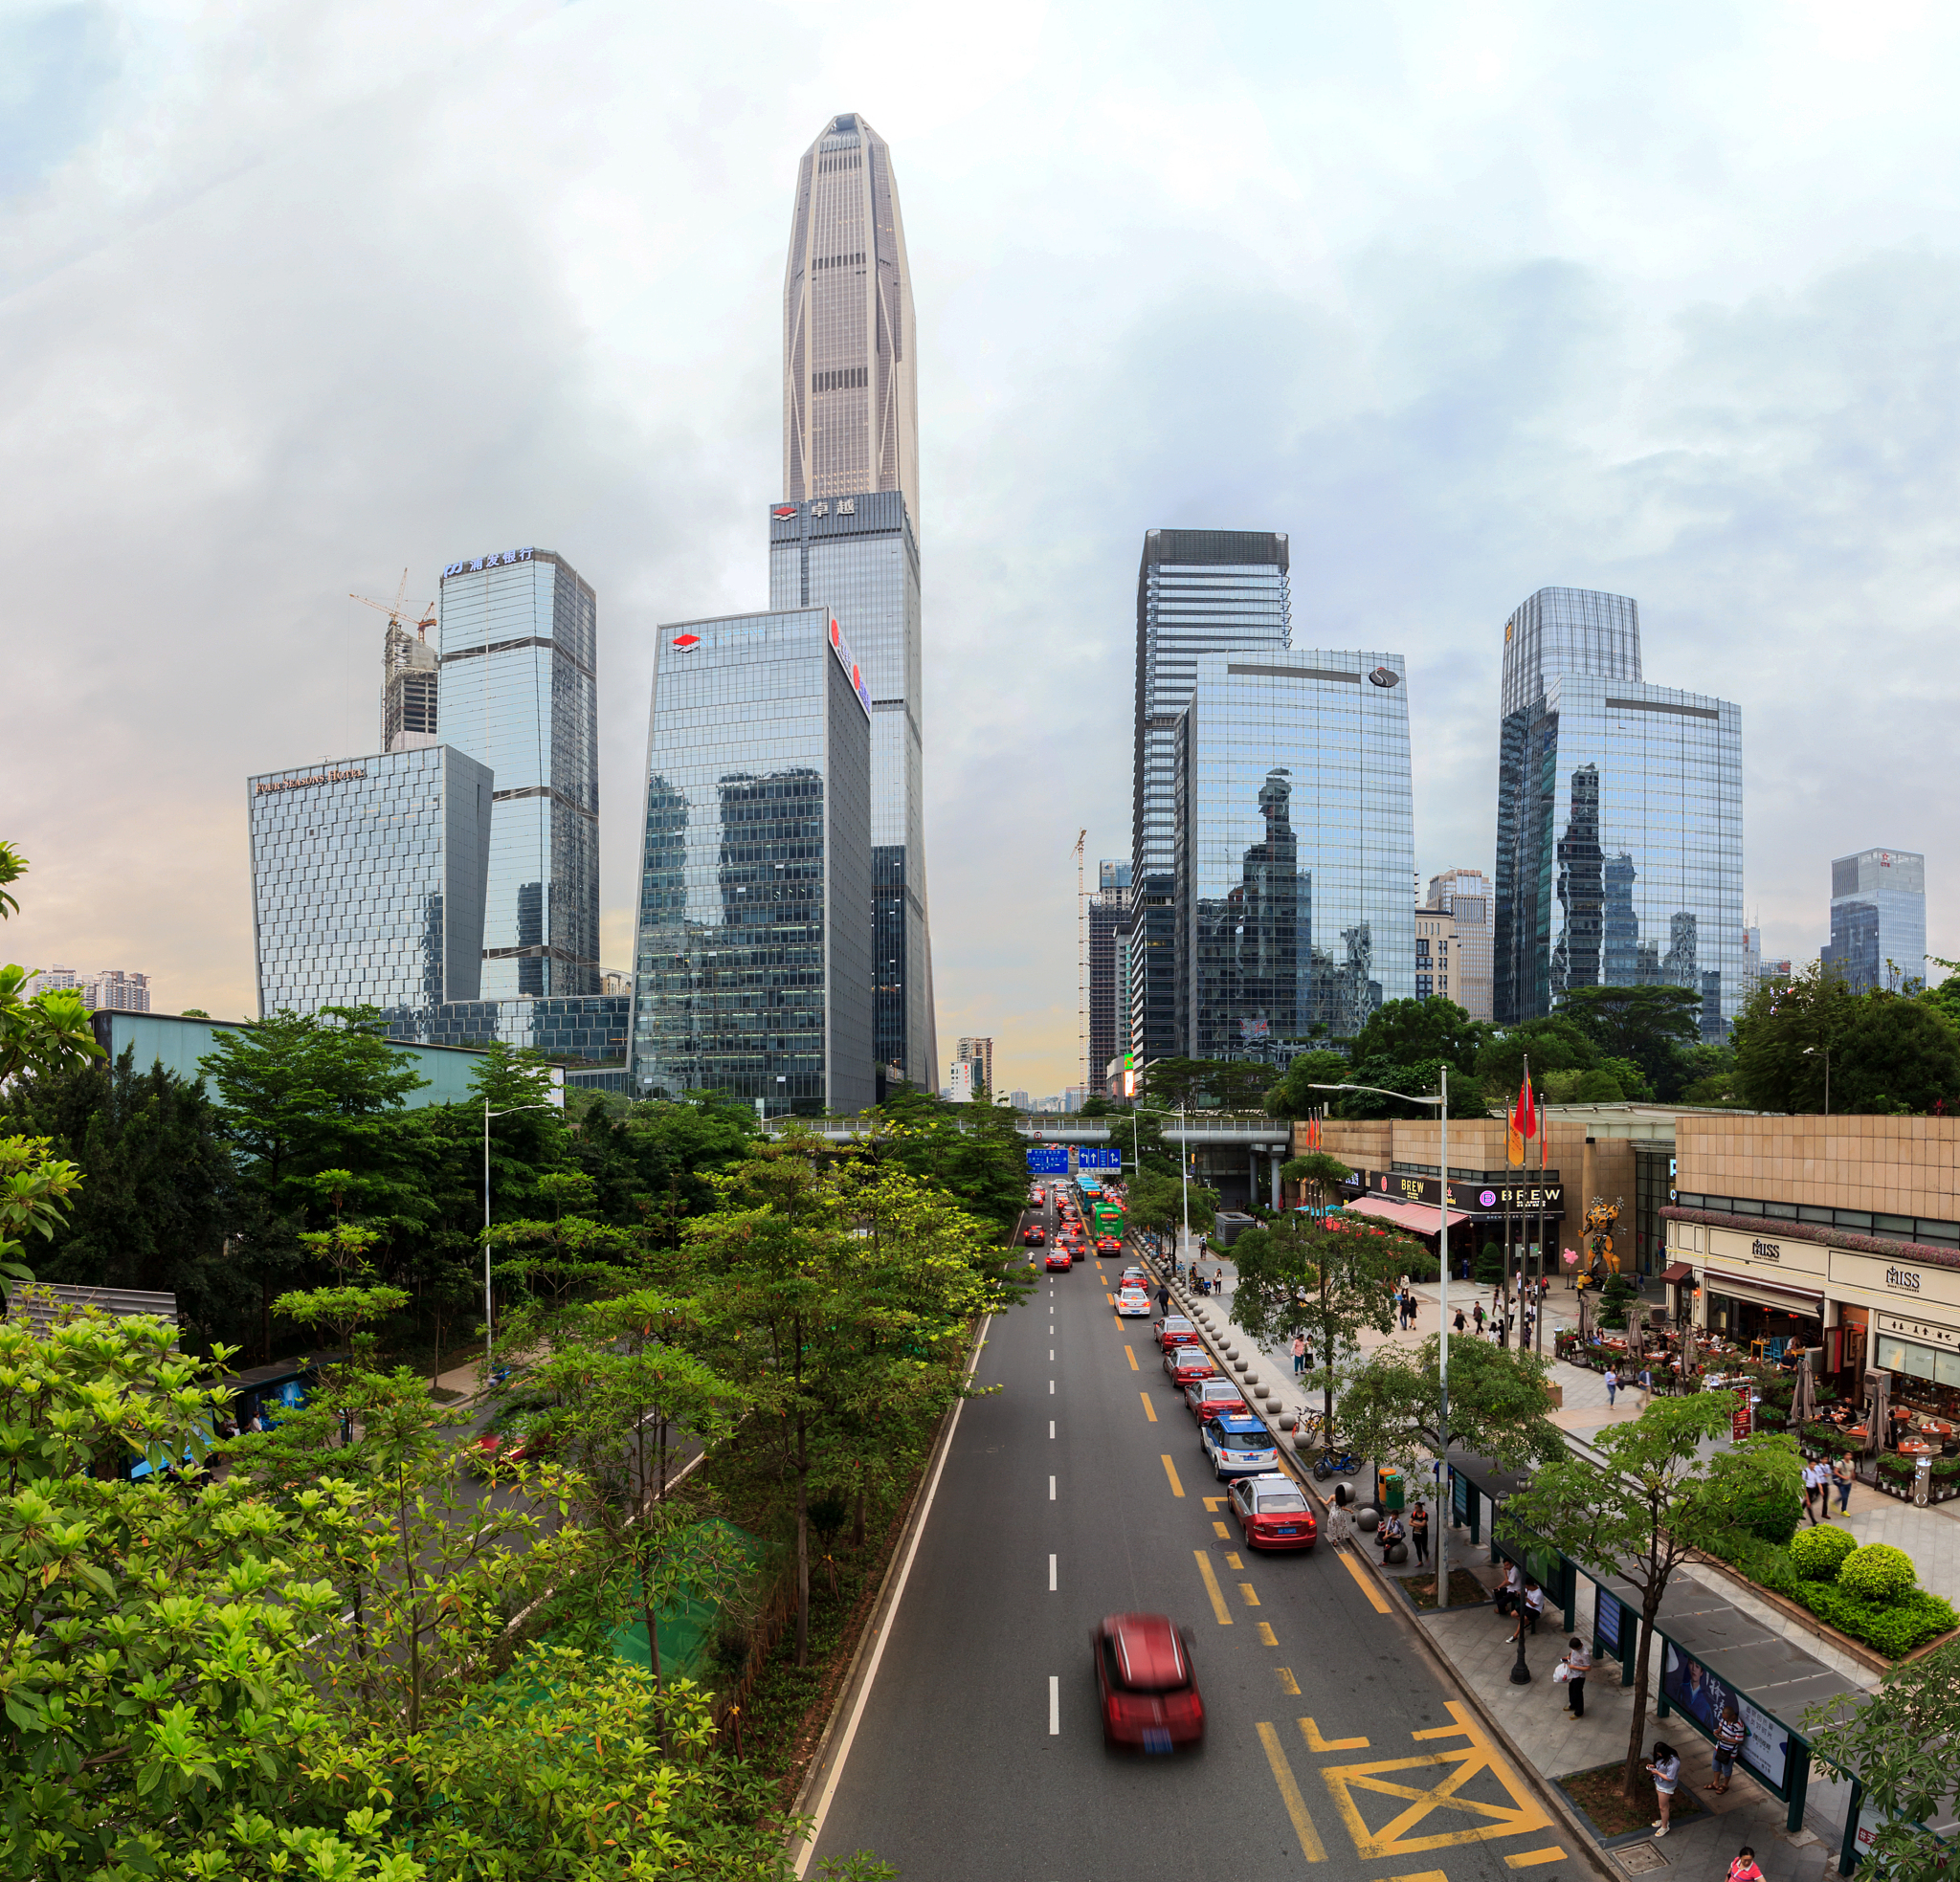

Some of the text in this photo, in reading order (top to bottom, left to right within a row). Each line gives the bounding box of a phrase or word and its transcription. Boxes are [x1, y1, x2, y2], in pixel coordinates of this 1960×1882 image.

[811, 498, 856, 518] 卓越
[469, 546, 534, 572] 浦发银行
[256, 768, 365, 794] FOUR SEASONS HOTEL
[1401, 1179, 1424, 1194] BREW
[1502, 1189, 1561, 1201] BREW
[1752, 1238, 1780, 1258] MISS
[1886, 1266, 1920, 1289] MISS
